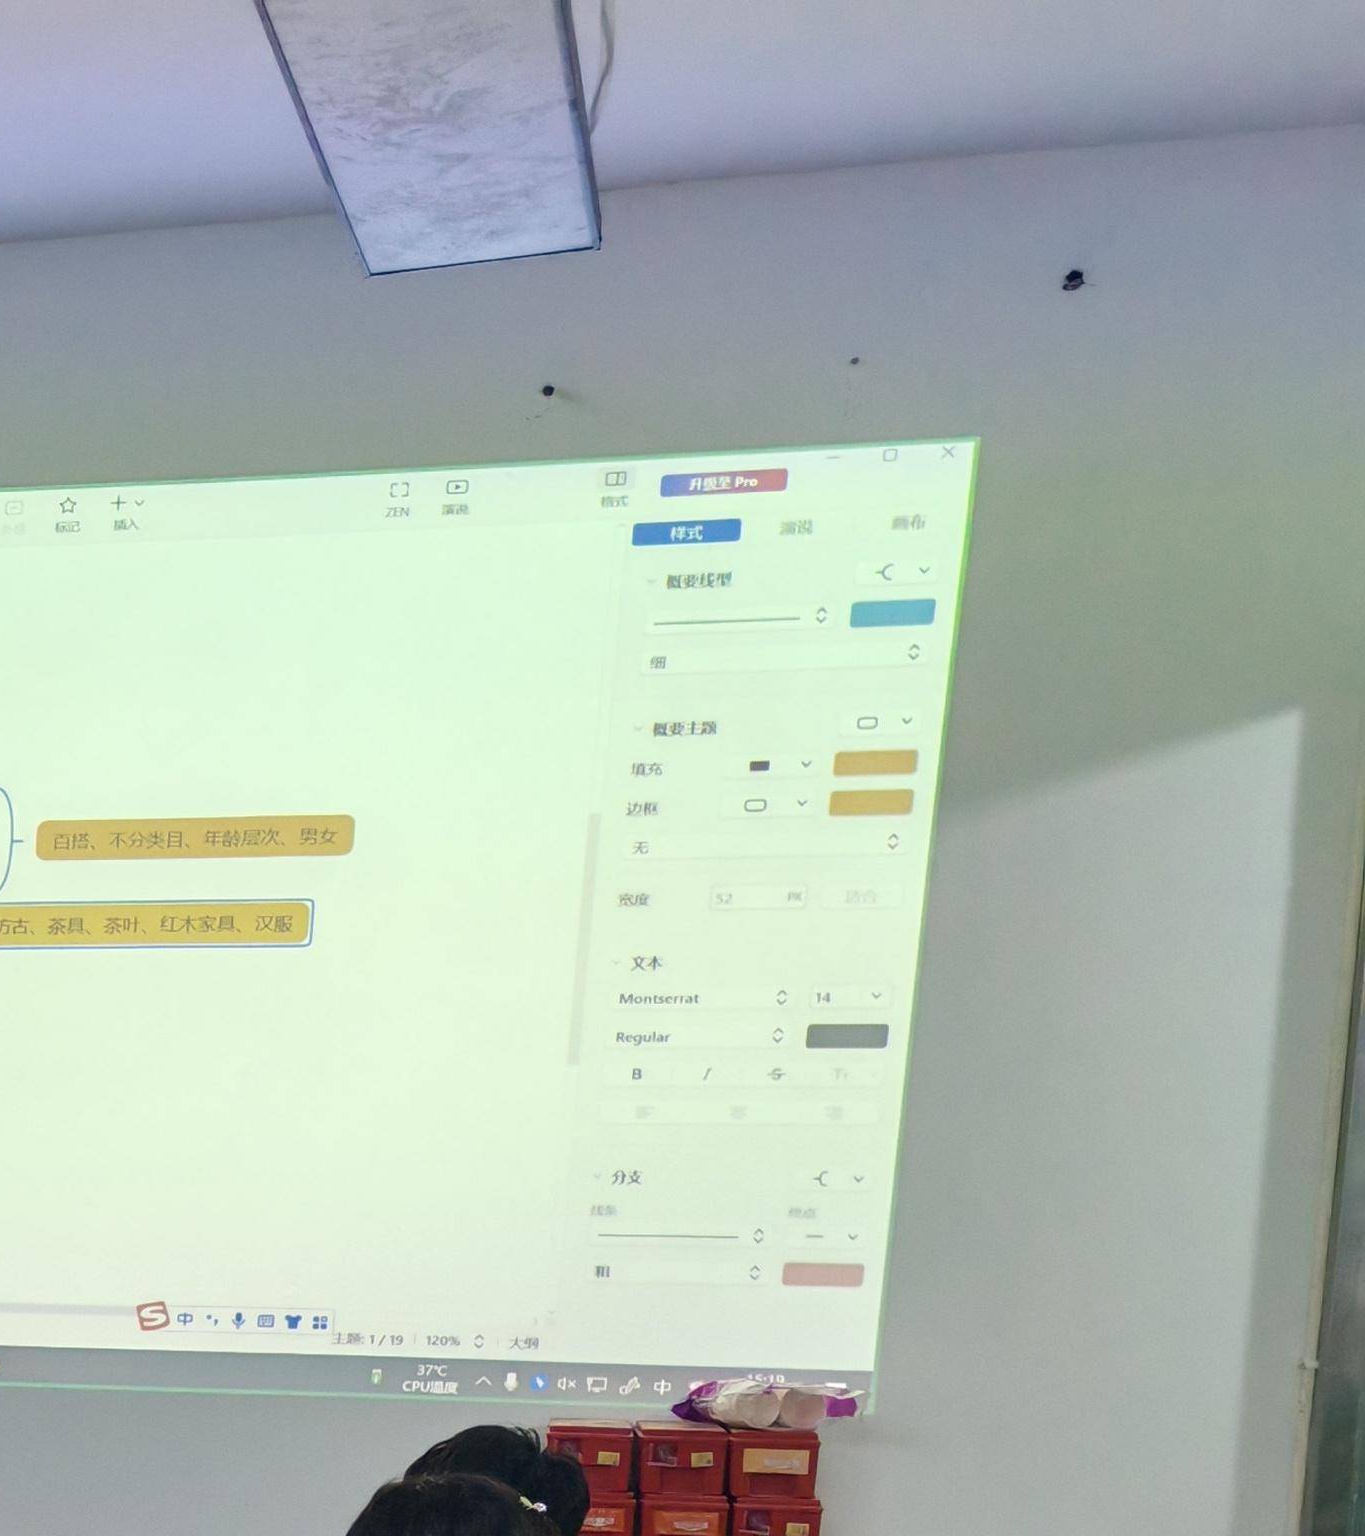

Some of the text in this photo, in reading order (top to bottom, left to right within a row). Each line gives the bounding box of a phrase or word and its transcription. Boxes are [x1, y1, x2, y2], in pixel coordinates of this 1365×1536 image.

[735, 475, 759, 488] Pro
[669, 525, 704, 542] 样式
[630, 955, 663, 971] 文本
[618, 993, 700, 1005] Montserrat
[816, 992, 831, 1003] 14
[615, 1031, 671, 1046] Regular
[611, 1170, 643, 1186] 分支
[176, 1311, 194, 1327] 中
[426, 1335, 461, 1347] 120%
